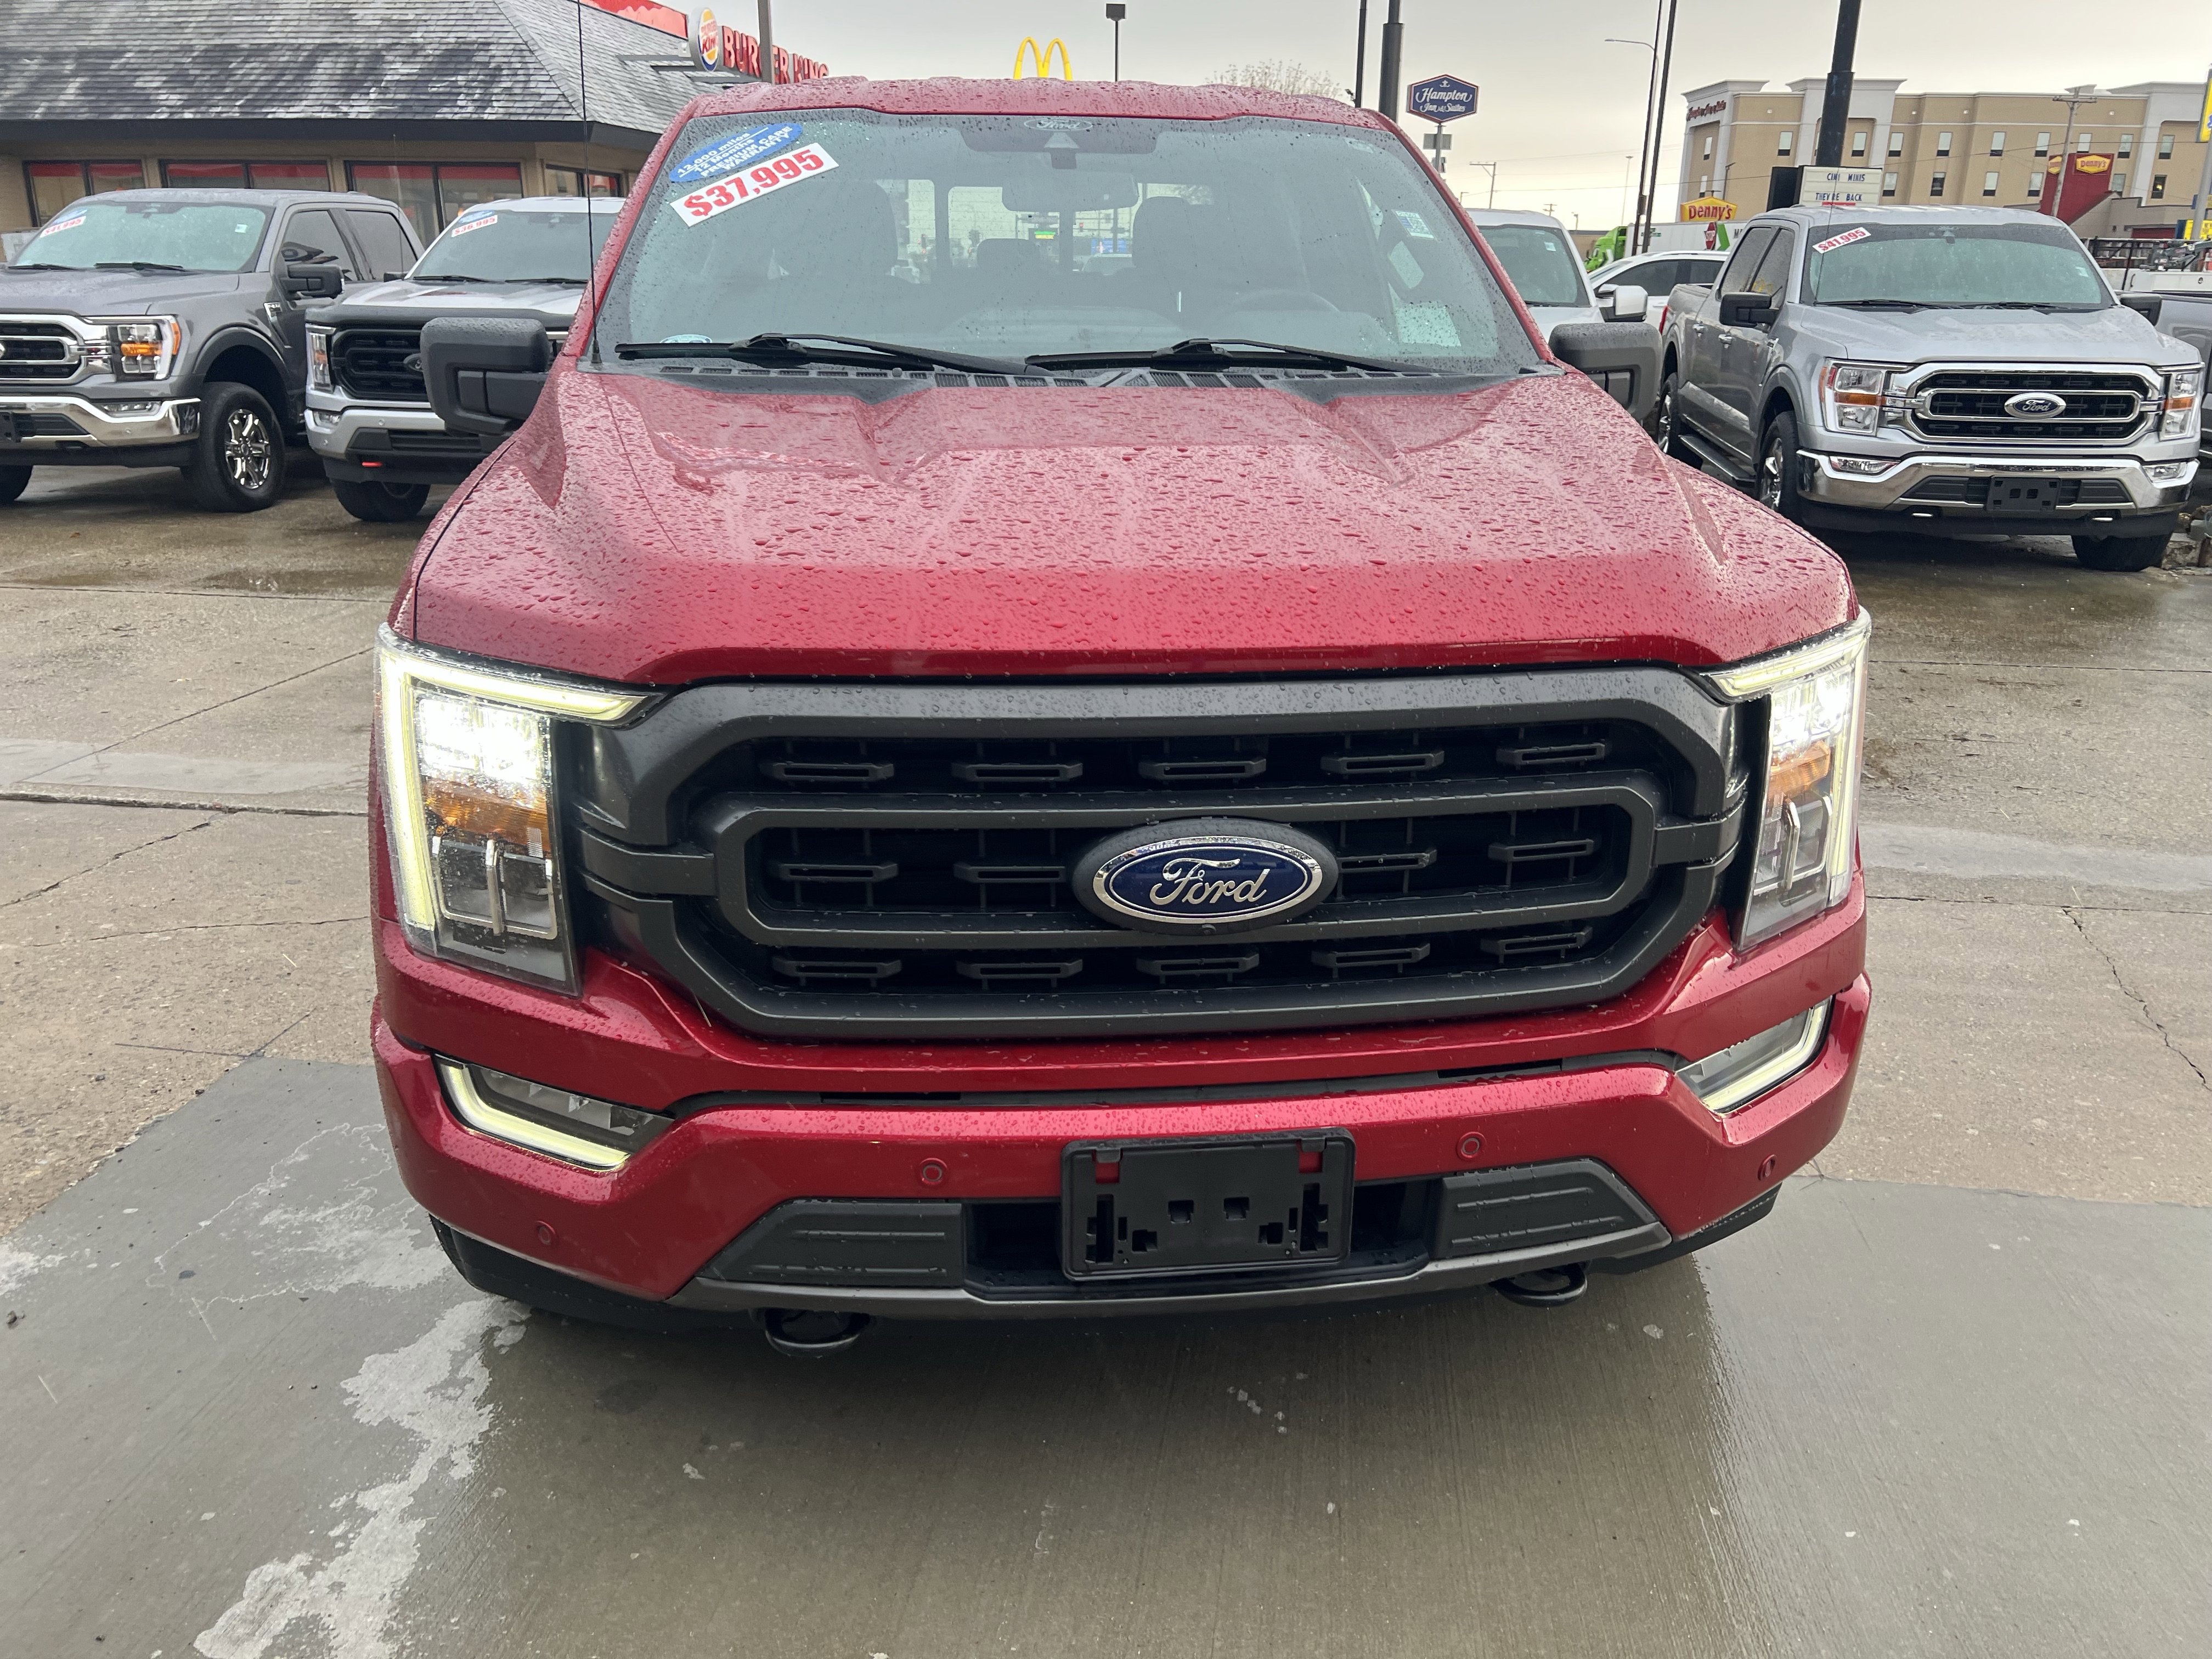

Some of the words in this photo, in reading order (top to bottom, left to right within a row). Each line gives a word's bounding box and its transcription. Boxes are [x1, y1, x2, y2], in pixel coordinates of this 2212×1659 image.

[722, 26, 789, 84] BURER
[1415, 87, 1472, 103] Hampton
[700, 144, 758, 177] PREMIUM
[758, 126, 793, 144] CARE
[710, 139, 754, 163] Months
[718, 133, 750, 151] miles
[723, 132, 790, 170] WARRANTY
[684, 149, 824, 217] $37,995
[1846, 193, 1863, 201] BACK
[1689, 204, 1733, 221] Denny's
[1818, 229, 1866, 251] $41,995
[2022, 399, 2052, 411] Ford
[1149, 857, 1271, 906] Ford
